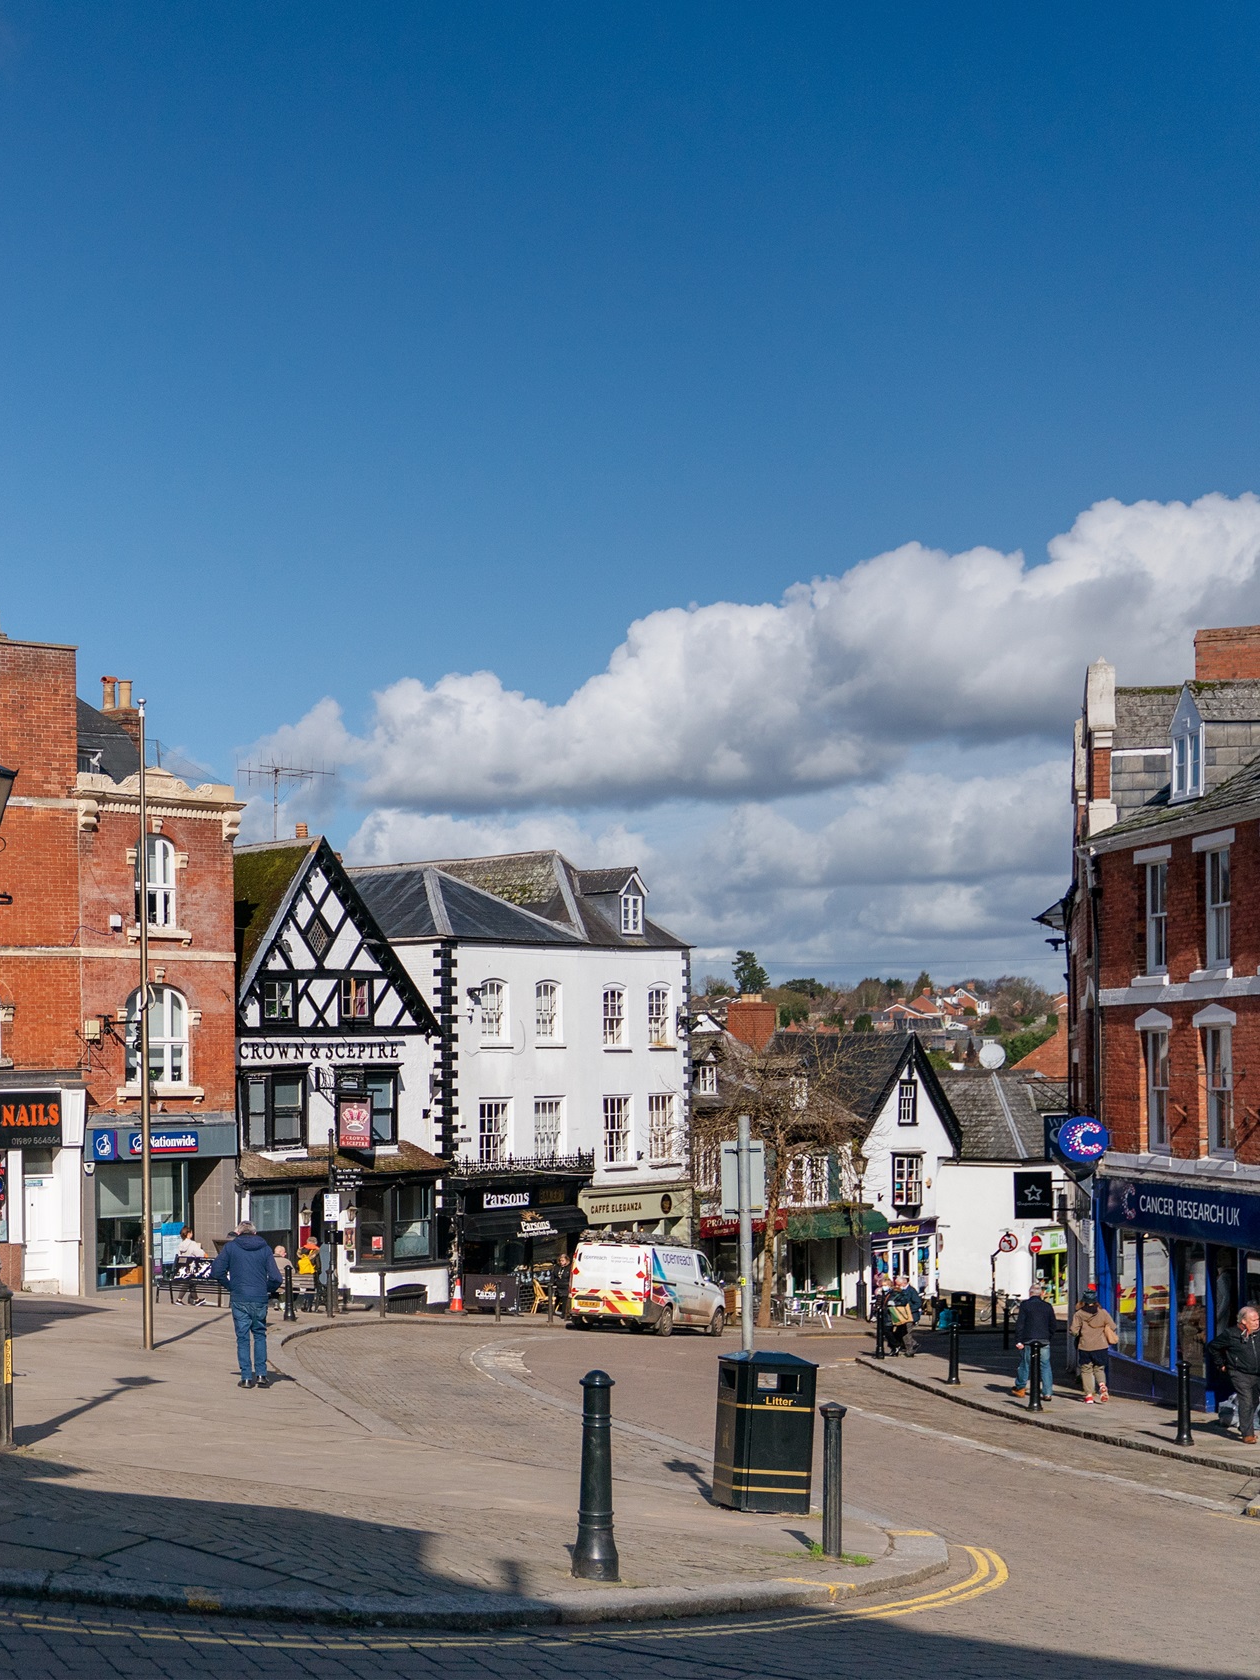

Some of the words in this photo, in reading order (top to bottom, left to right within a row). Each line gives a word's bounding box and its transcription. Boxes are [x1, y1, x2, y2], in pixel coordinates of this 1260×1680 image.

[238, 1042, 305, 1060] CROWN
[310, 1042, 321, 1060] &
[325, 1042, 399, 1060] SCEPTRE
[1, 1103, 60, 1127] NAILS
[11, 1138, 32, 1146] 01989
[150, 1134, 196, 1148] Nationwide
[483, 1192, 530, 1208] Parsons
[590, 1202, 609, 1214] CAFFÉ
[612, 1201, 642, 1213] ELEGANZA
[1139, 1194, 1174, 1217] CANCER
[1177, 1199, 1224, 1224] RESEARCH
[1226, 1206, 1240, 1227] UK
[521, 1220, 550, 1232] Parsons
[706, 1217, 740, 1228] PRONTO
[888, 1226, 900, 1235] Card
[901, 1224, 920, 1234] Factory
[662, 1252, 693, 1267] openreach
[765, 1396, 794, 1406] Litter
